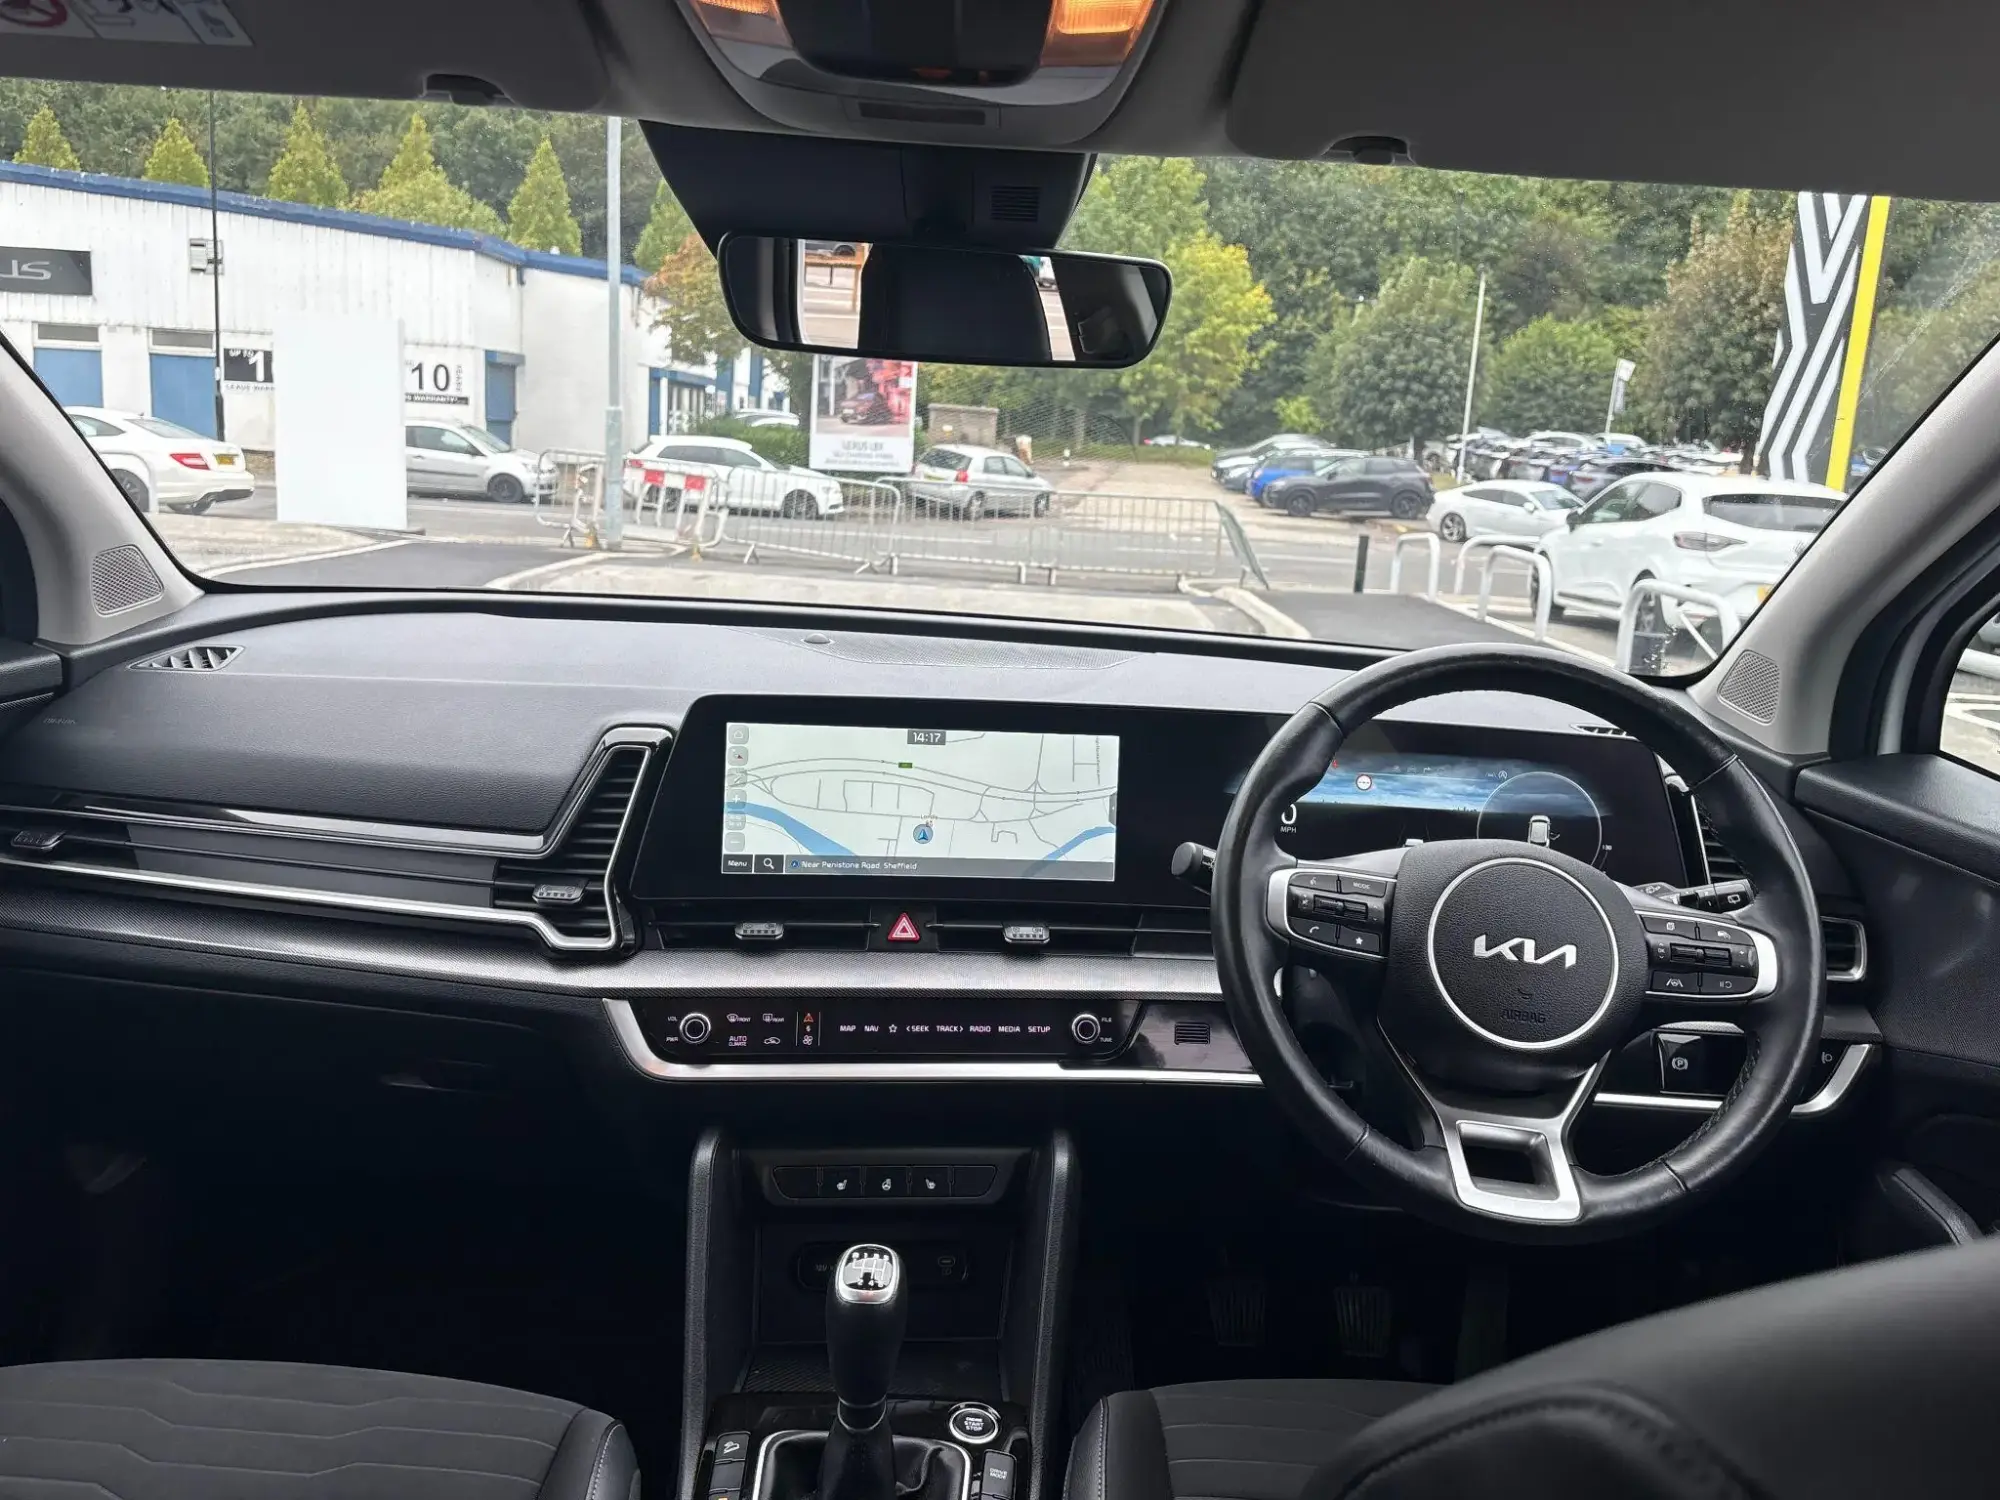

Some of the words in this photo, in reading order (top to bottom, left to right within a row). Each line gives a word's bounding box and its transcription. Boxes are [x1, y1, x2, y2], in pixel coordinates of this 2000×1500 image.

[411, 362, 450, 392] 10
[912, 730, 942, 744] 14:17
[1280, 825, 1298, 833] MPH
[727, 859, 748, 868] Menu
[801, 860, 820, 869] Near
[821, 860, 860, 869] Penistone
[883, 862, 918, 871] Sheffield
[1352, 882, 1371, 890] MODE
[1501, 1008, 1546, 1024] AIRBAG
[911, 1024, 930, 1033] SEEK
[936, 1024, 959, 1033] TRACK
[969, 1025, 992, 1033] RADIO
[998, 1025, 1021, 1033] MEDIA
[1027, 1025, 1051, 1034] SETUP
